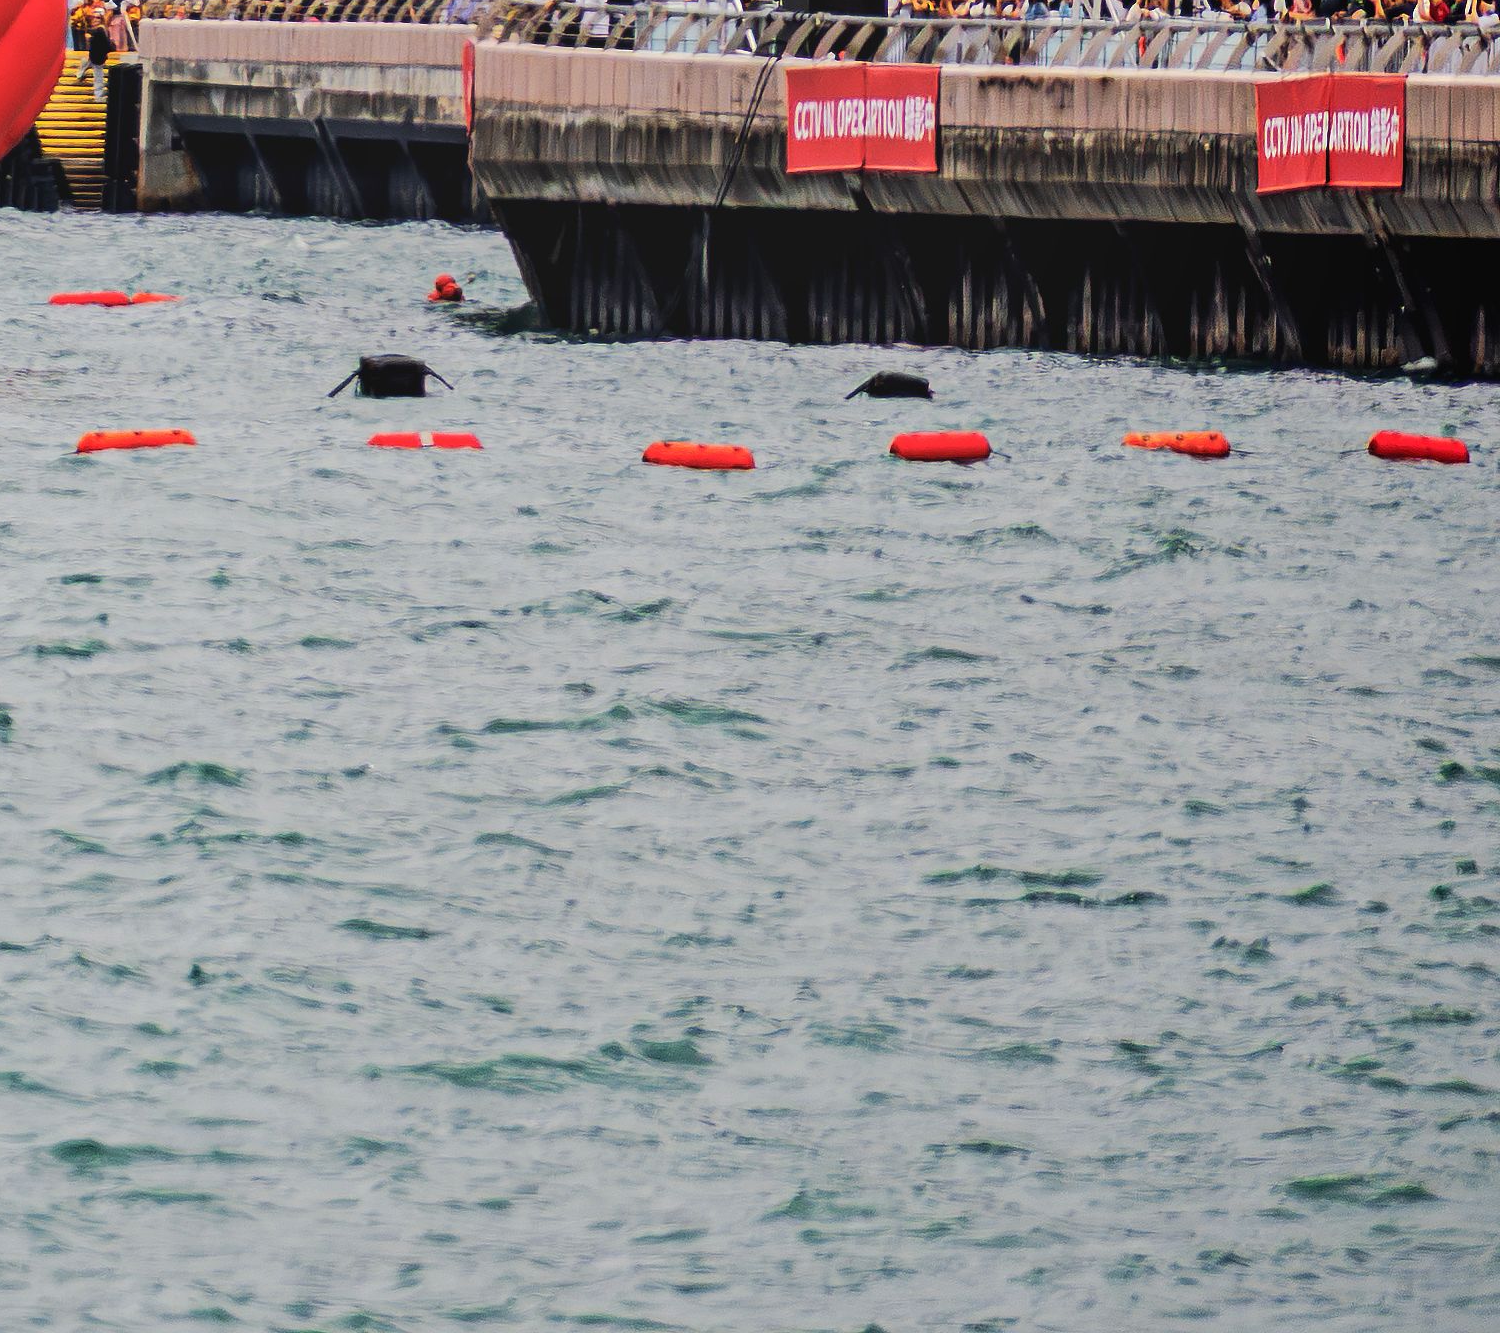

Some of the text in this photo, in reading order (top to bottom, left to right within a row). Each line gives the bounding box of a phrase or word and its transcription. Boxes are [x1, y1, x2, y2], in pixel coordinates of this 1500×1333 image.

[794, 100, 823, 141] CCTV
[823, 99, 835, 139] IN
[1264, 116, 1290, 160] CCTV
[1290, 115, 1302, 157] IN
